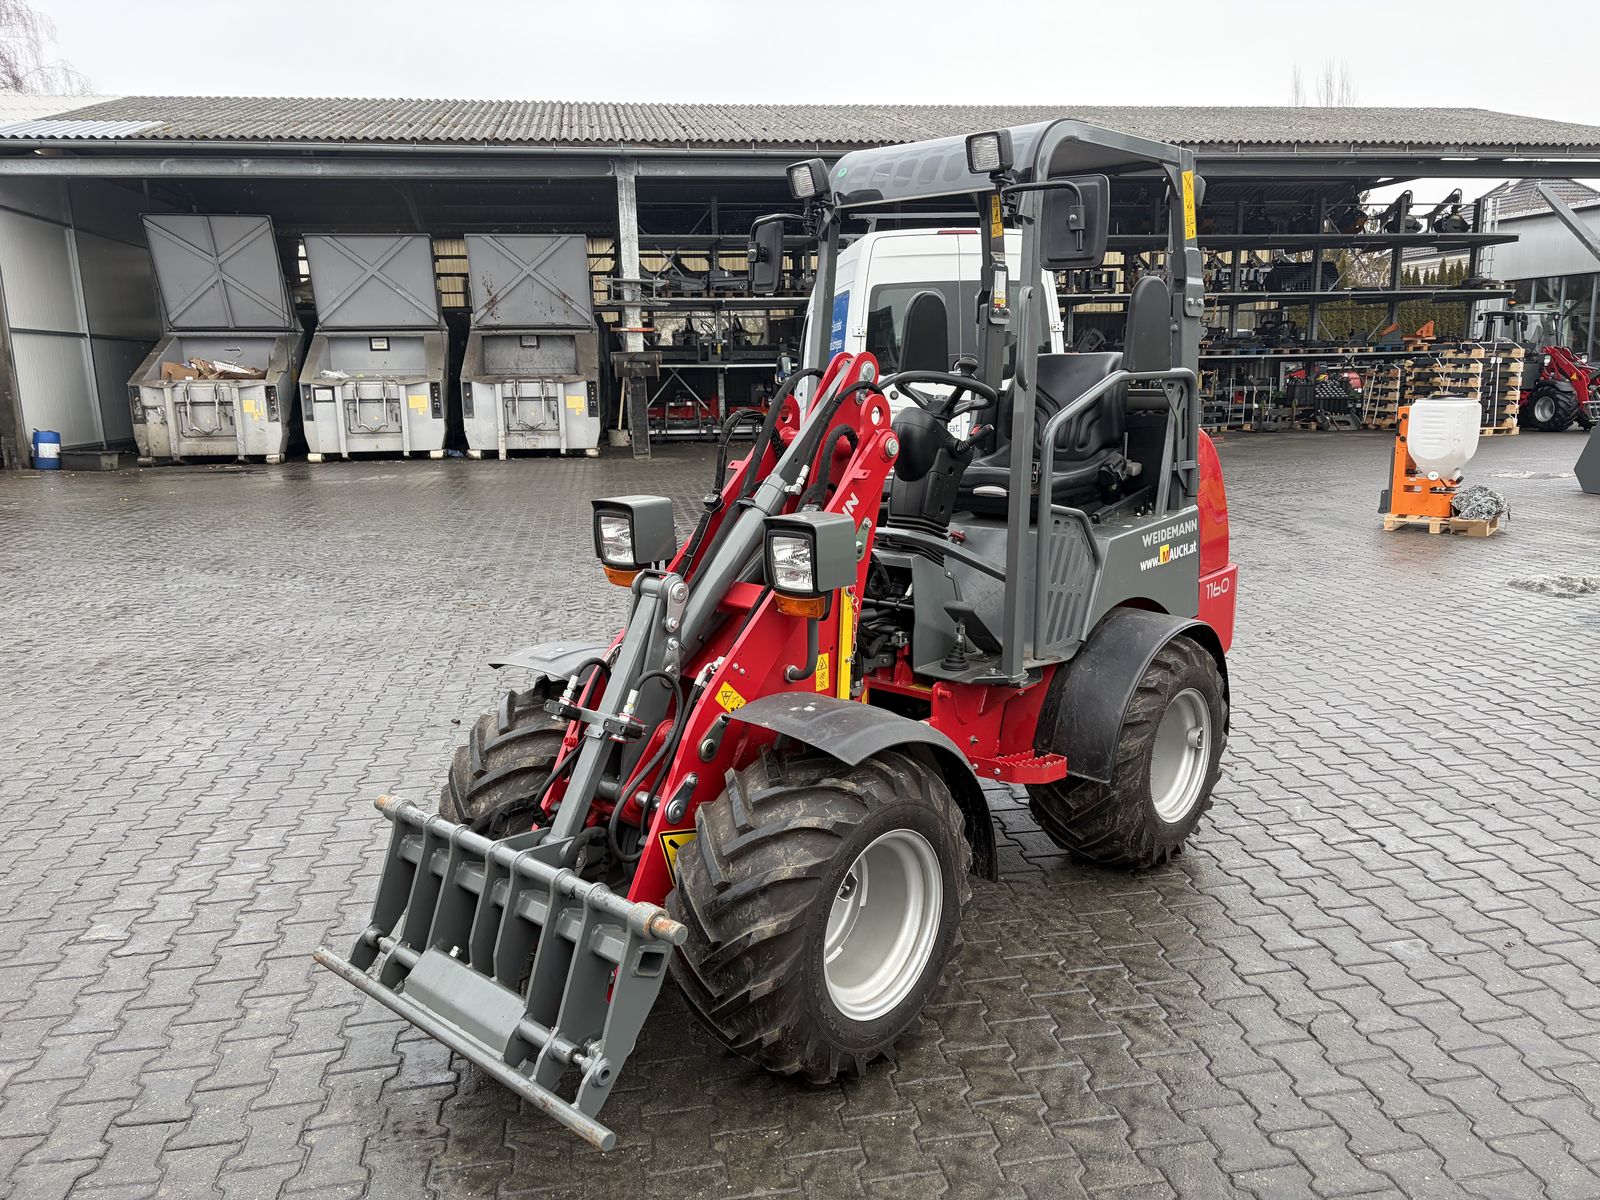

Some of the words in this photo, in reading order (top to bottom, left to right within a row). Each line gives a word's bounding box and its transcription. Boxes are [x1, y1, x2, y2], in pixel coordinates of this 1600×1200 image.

[1142, 518, 1198, 548] WEIDEMANN
[1140, 540, 1197, 571] www.MAUCH.at
[1206, 577, 1230, 599] 1160
